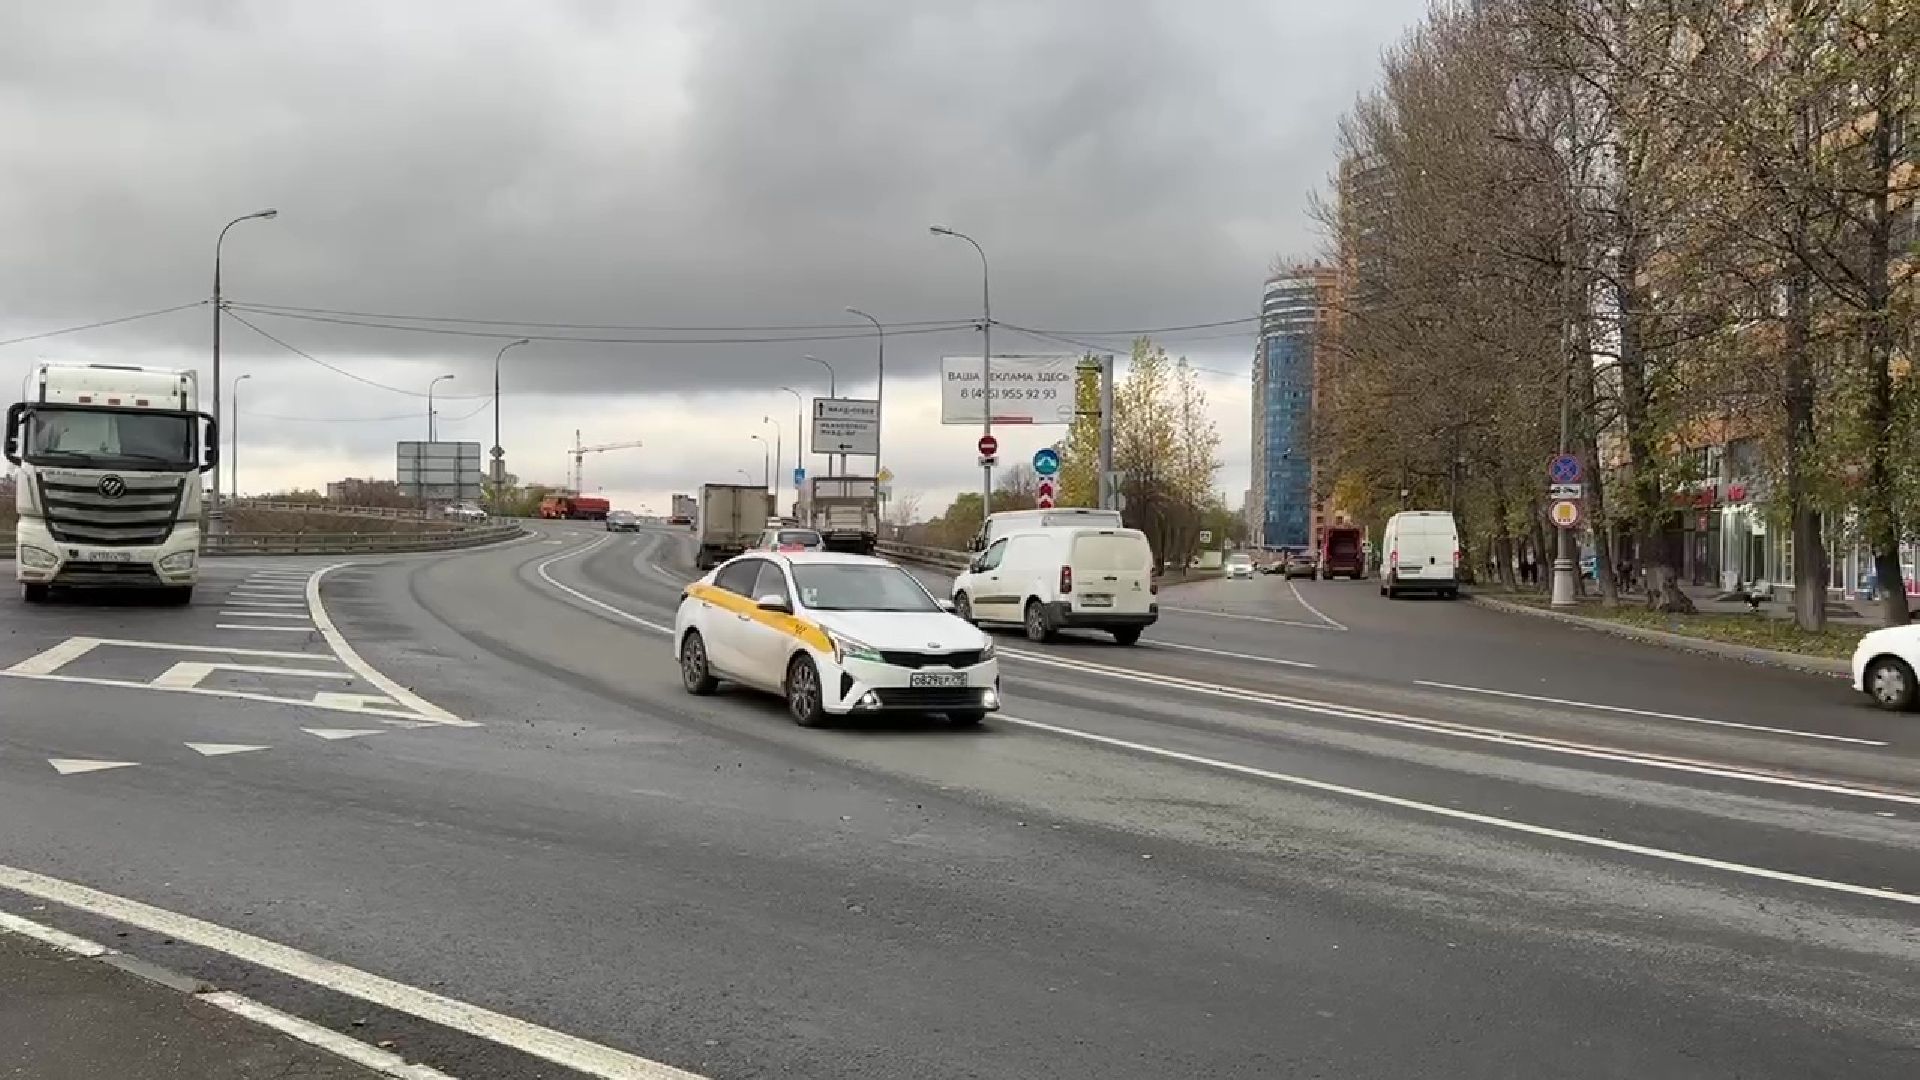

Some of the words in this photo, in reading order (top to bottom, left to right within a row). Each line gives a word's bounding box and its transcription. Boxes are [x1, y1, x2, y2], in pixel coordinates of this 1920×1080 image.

[948, 371, 980, 381] ВАША
[985, 372, 1034, 381] ЕКЛАМА
[1037, 372, 1070, 382] ЗДЕСЬ
[960, 388, 968, 399] 8
[1002, 388, 1024, 400] 955
[1026, 388, 1040, 400] 92
[1042, 389, 1057, 400] 93
